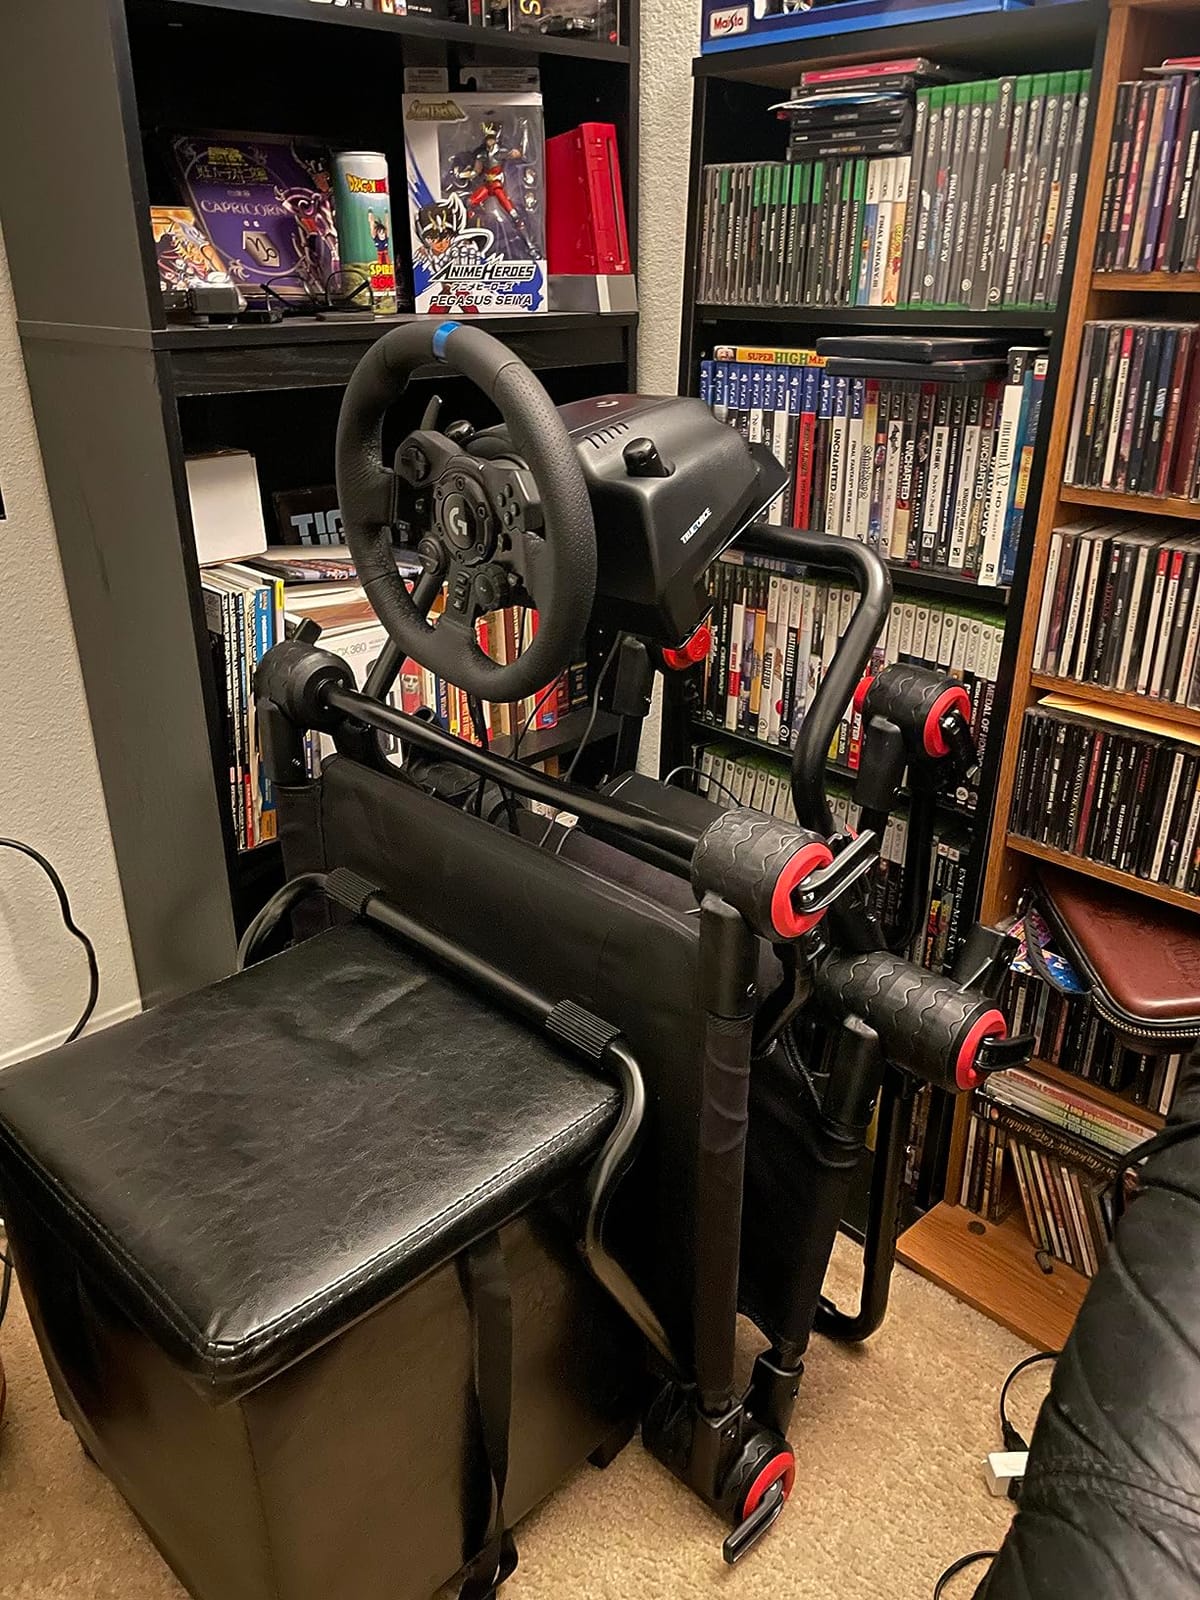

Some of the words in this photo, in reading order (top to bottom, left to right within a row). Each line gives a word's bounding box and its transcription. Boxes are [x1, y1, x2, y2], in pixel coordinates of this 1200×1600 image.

[713, 10, 744, 32] Maisto
[947, 173, 957, 201] FINAL
[1004, 172, 1015, 205] MASS
[1066, 172, 1077, 207] DRAGON
[201, 200, 288, 216] CAPRICORN
[1063, 208, 1072, 229] BALL
[877, 215, 885, 239] FINAL
[919, 212, 928, 240] FORZA
[942, 202, 954, 245] FANTASY
[998, 206, 1010, 252] EFFECT
[982, 234, 991, 252] WILD
[1011, 225, 1021, 258] KINGDOM
[872, 240, 882, 278] FANTASY
[940, 249, 948, 262] XV
[980, 252, 988, 272] HUNT
[1007, 259, 1016, 285] HEARTS
[430, 295, 492, 306] PEGASUS
[496, 295, 532, 306] SEIYA
[747, 352, 773, 361] SUPER
[775, 352, 808, 364] HIGH
[1011, 356, 1023, 383] PS3
[829, 428, 841, 492] UNCHARTED
[847, 458, 855, 485] FANTASY
[899, 440, 915, 500] UNCHARTED
[974, 436, 990, 500] UNCHARTED
[960, 487, 969, 517] KINGDOM
[994, 489, 1002, 508] HD
[957, 518, 965, 542] HEARTS
[350, 642, 367, 656] 360
[983, 684, 996, 716] MEDAL
[980, 718, 990, 733] OF
[954, 867, 966, 898] ENTER
[945, 908, 960, 952] MATRIX
